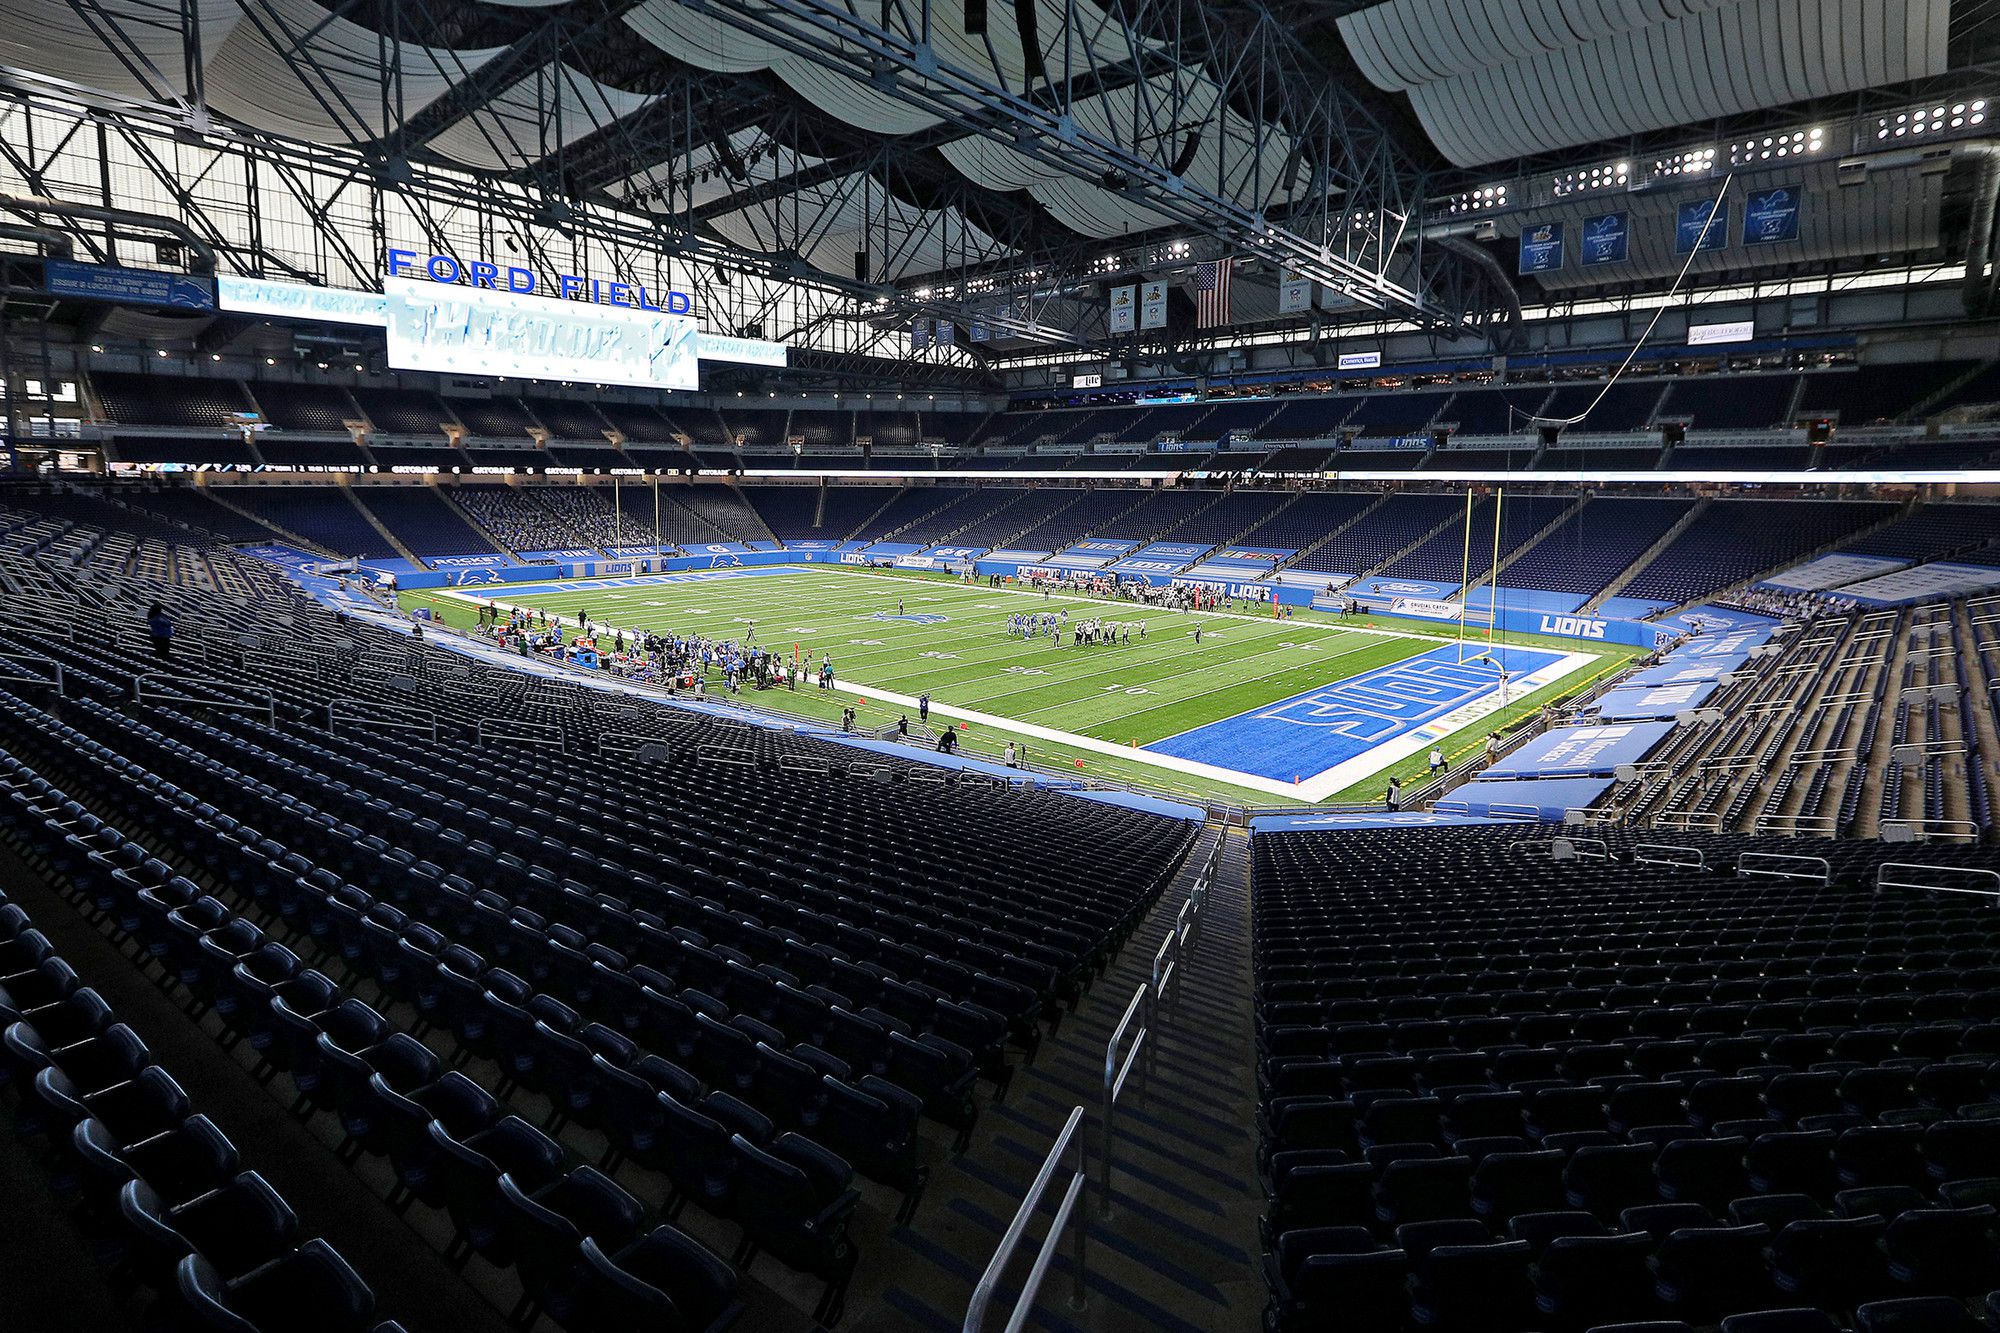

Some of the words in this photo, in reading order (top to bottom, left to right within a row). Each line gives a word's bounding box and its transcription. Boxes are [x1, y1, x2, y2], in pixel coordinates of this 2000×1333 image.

[389, 249, 536, 293] FORD
[560, 275, 691, 314] FIELD
[1086, 376, 1099, 387] Lite
[392, 466, 439, 474] GATORADE
[562, 549, 593, 558] ONE
[613, 546, 654, 555] PRIDE
[433, 556, 501, 565] ROCKET
[840, 553, 865, 565] LIONS
[605, 563, 632, 573] LIONS
[1120, 560, 1177, 570] LIONS
[1230, 583, 1271, 601] LIONS
[1539, 615, 1608, 639] LIONS
[1101, 684, 1148, 695] 10
[1250, 659, 1526, 742] LIONS
